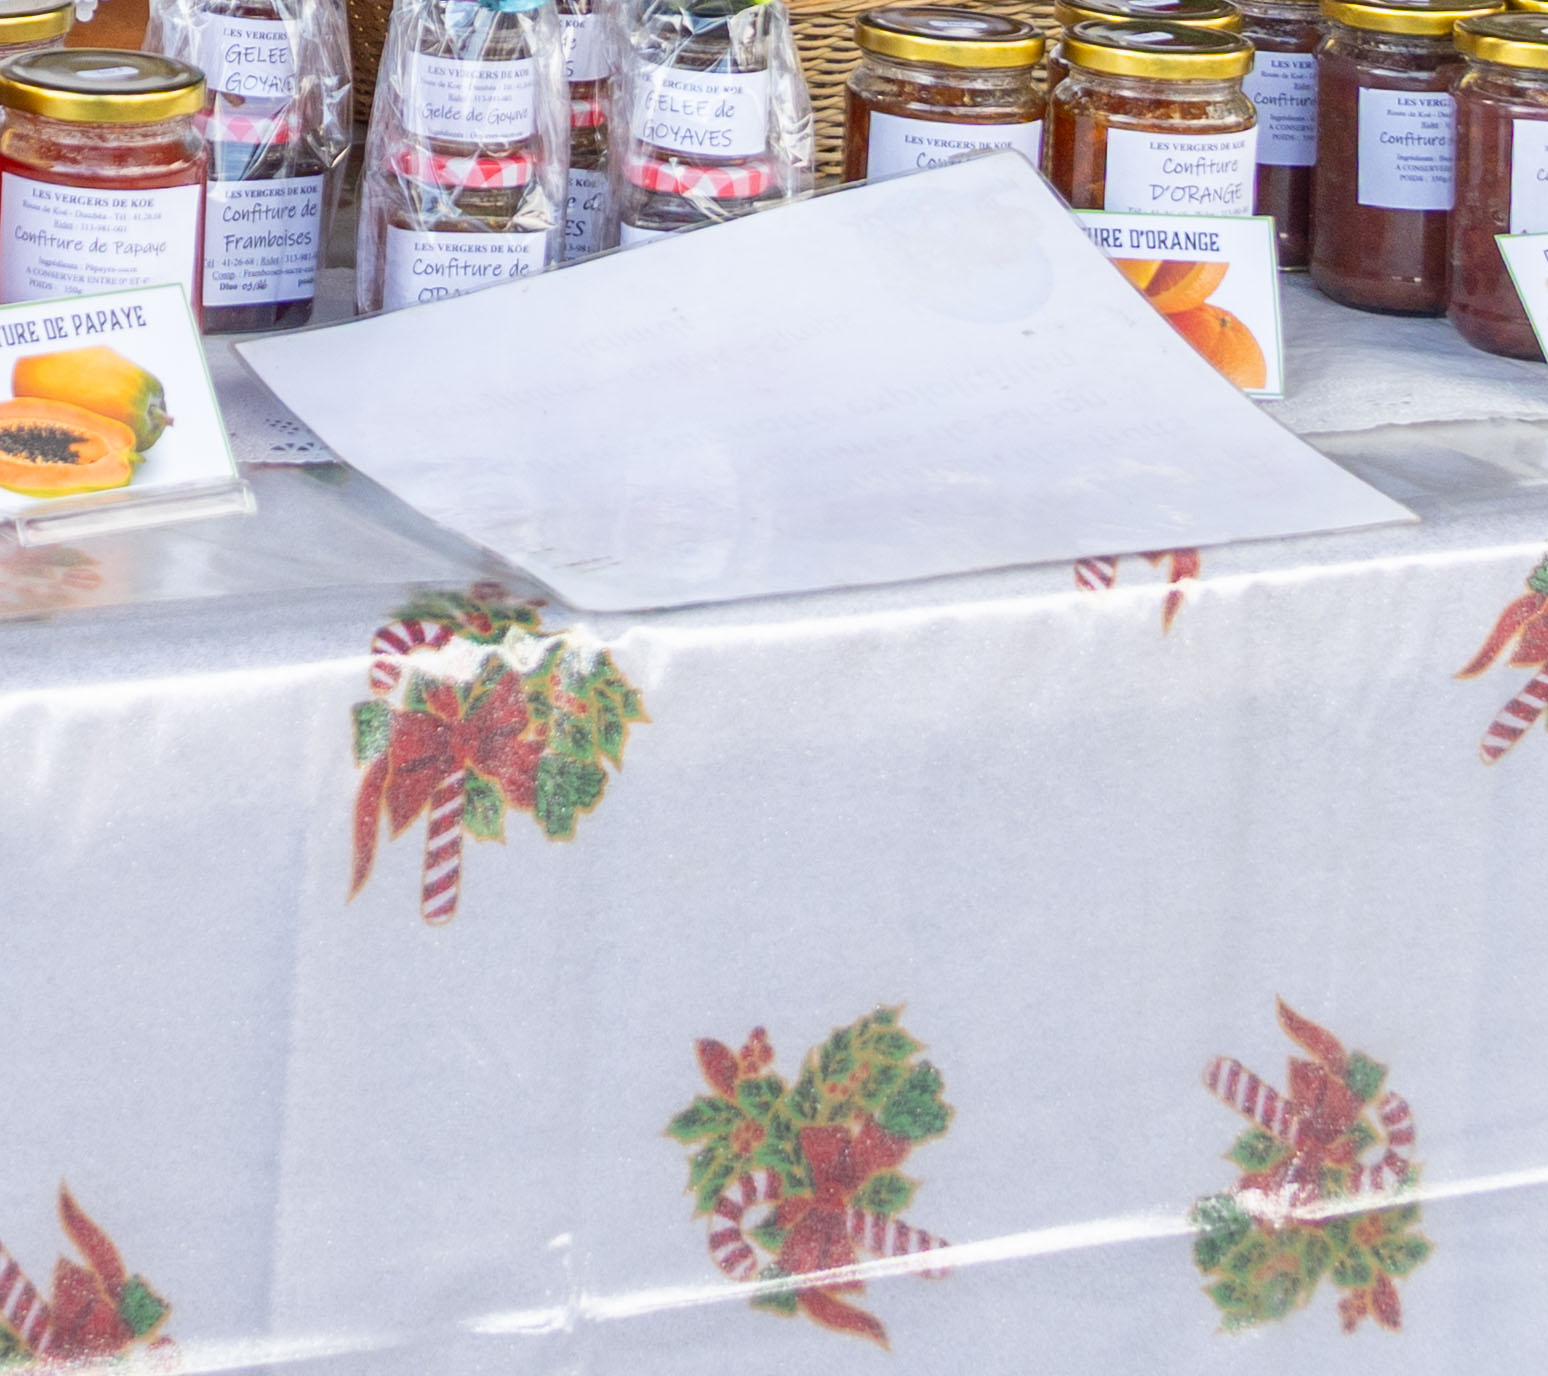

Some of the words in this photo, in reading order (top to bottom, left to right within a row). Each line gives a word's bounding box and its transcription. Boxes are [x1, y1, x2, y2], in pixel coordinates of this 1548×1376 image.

[245, 29, 288, 41] VERGERS
[224, 44, 289, 65] GELEE
[1270, 59, 1290, 68] LES
[427, 66, 446, 76] LES
[500, 69, 513, 79] DE
[715, 99, 735, 118] de
[1397, 98, 1417, 106] LES
[422, 103, 462, 121] Gelée
[466, 104, 483, 121] de
[643, 122, 732, 147] GOYAVES
[904, 135, 924, 146] LES
[926, 136, 975, 149] VERGERS
[1379, 131, 1446, 147] Confiture
[1148, 141, 1171, 151] LES
[1172, 142, 1219, 152] VERGERS
[1162, 157, 1239, 176] Confiture
[32, 187, 51, 200] LES
[54, 192, 109, 208] VERGERS
[112, 198, 127, 208] DE
[130, 198, 154, 208] KOE
[244, 186, 286, 198] VERGERS
[287, 185, 299, 196] DE
[300, 184, 318, 195] KOE
[1149, 183, 1243, 202] D'ORANGE
[222, 203, 297, 224] Confiture
[300, 198, 318, 218] de
[15, 225, 83, 252] Confiture
[89, 237, 107, 254] de
[113, 241, 166, 258] Papaye
[224, 229, 312, 253] Framboises
[414, 242, 435, 252] LES
[437, 242, 488, 253] VERGERS
[490, 243, 504, 253] DE
[507, 243, 529, 253] KOE
[1130, 228, 1220, 252] D'ORANGE
[412, 257, 502, 278] Confiture
[509, 258, 529, 277] de
[43, 317, 69, 340] DE
[70, 305, 147, 336] PAPAYE
